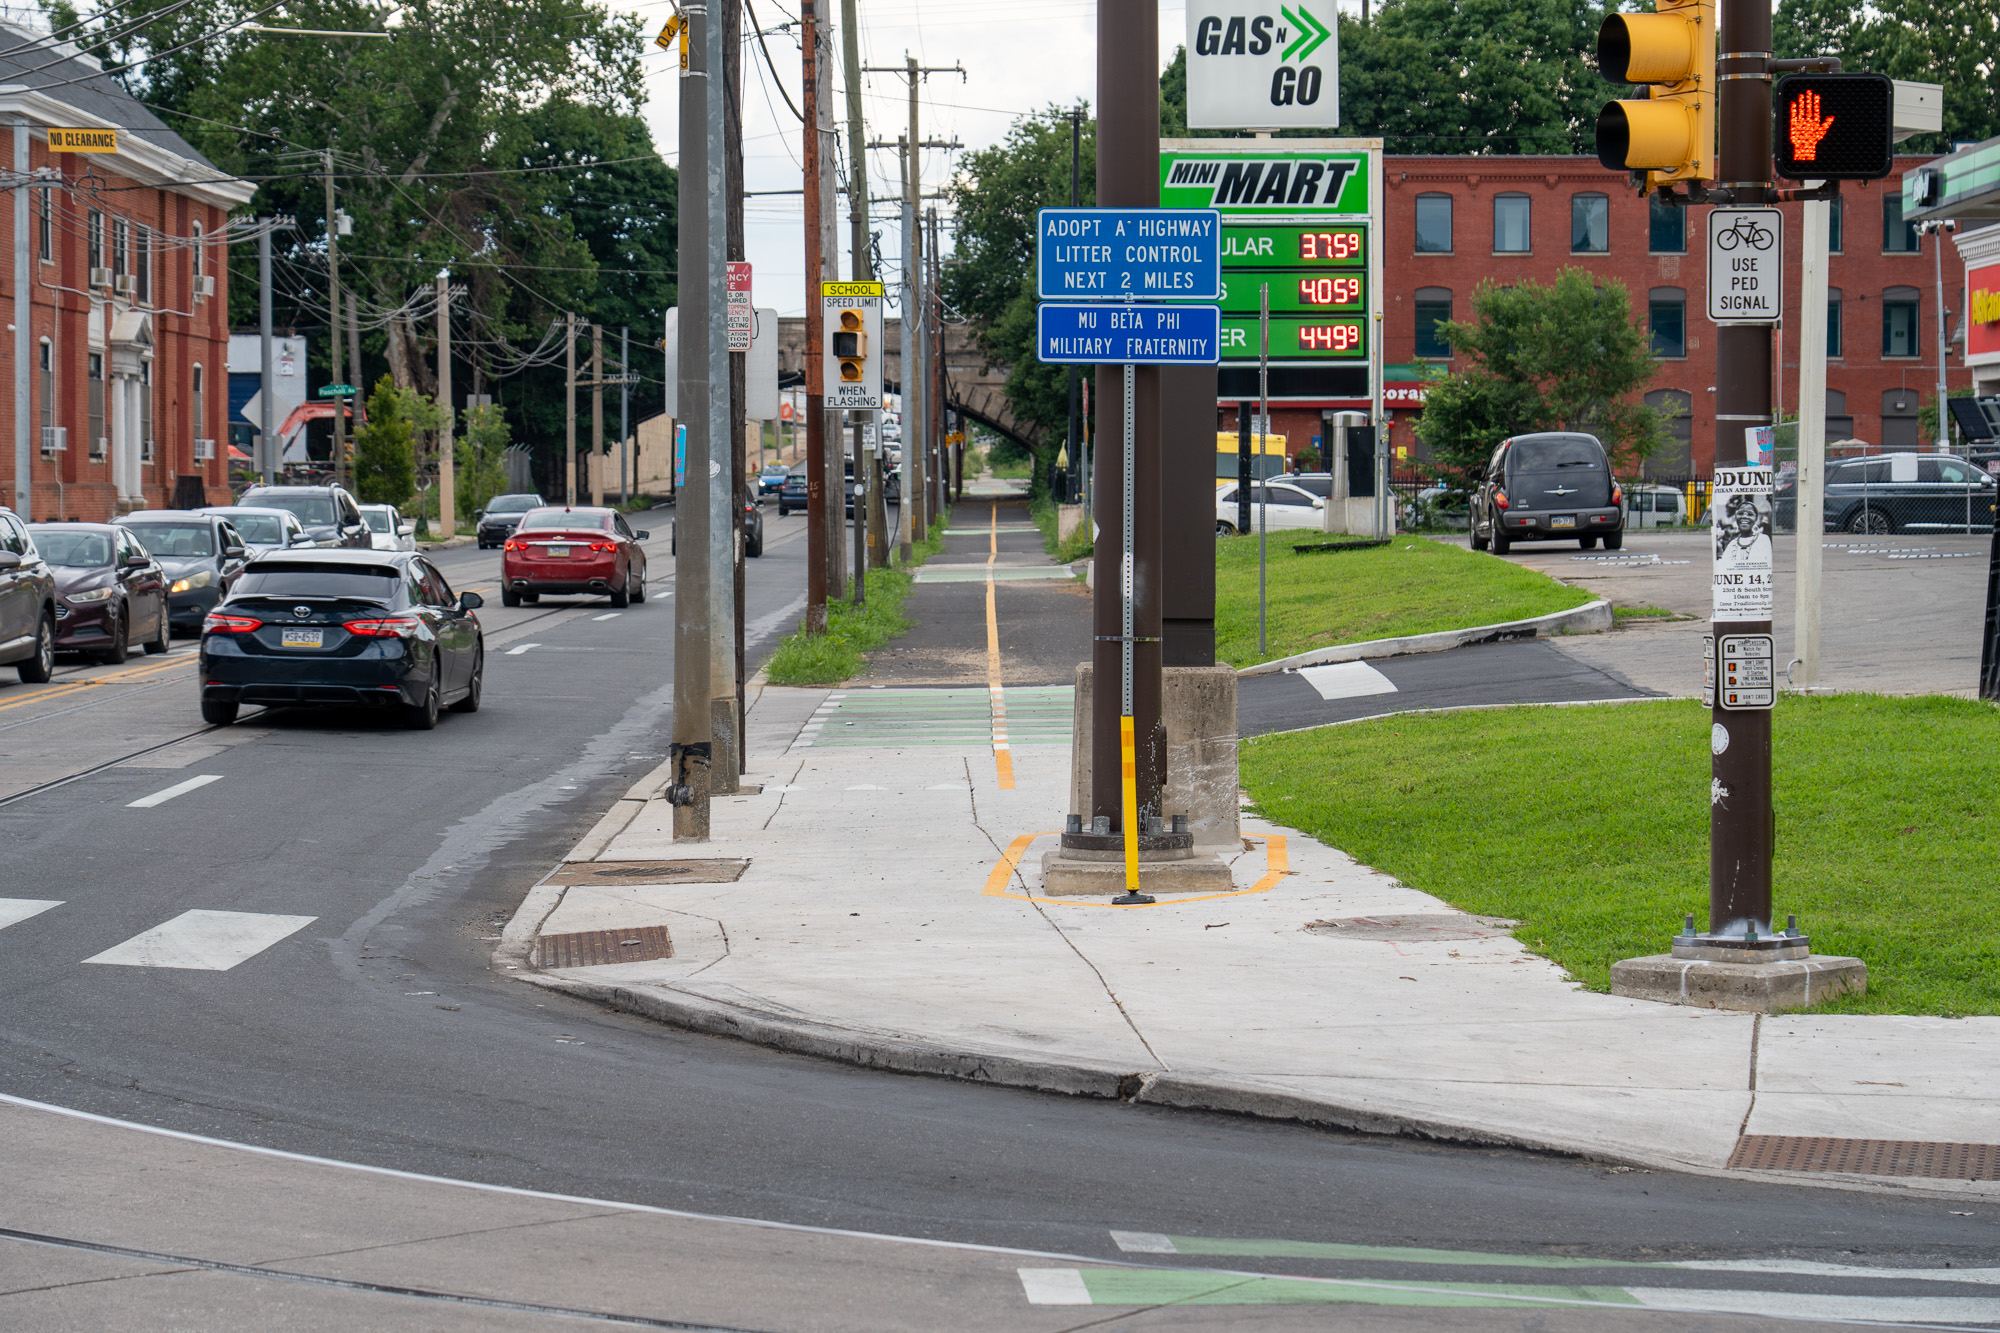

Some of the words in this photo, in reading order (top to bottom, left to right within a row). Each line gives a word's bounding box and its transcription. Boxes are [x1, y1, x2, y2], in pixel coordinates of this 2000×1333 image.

[1196, 15, 1274, 56] GAS
[1276, 27, 1287, 44] N
[1270, 65, 1322, 106] GO
[50, 132, 62, 146] NO
[65, 132, 114, 147] CLEARANCE
[1170, 162, 1221, 184] MINI
[1214, 162, 1356, 204] MART
[1047, 219, 1102, 237] ADOPT
[1115, 219, 1126, 237] A
[1138, 219, 1212, 237] HIGHWAY
[1056, 245, 1112, 263] LITTER
[1125, 245, 1203, 263] CONTROL
[1732, 257, 1759, 272] USE
[727, 273, 749, 282] NCY
[1064, 271, 1107, 289] NEXT
[1120, 271, 1131, 289] 2
[1144, 271, 1194, 289] MILES
[1731, 276, 1759, 291] PED
[829, 285, 876, 295] SCHOOL
[826, 298, 853, 308] SPEED
[857, 298, 878, 307] LIMIT
[1720, 295, 1770, 310] SIGNAL
[1078, 312, 1097, 329] MU
[1110, 312, 1143, 329] BETA
[1157, 313, 1180, 330] PHI
[1050, 337, 1113, 355] MILITARY
[1126, 338, 1208, 356] FRATERNITY
[838, 386, 866, 396] WHEN
[827, 396, 877, 407] FLASHING
[1714, 574, 1743, 585] JUNE
